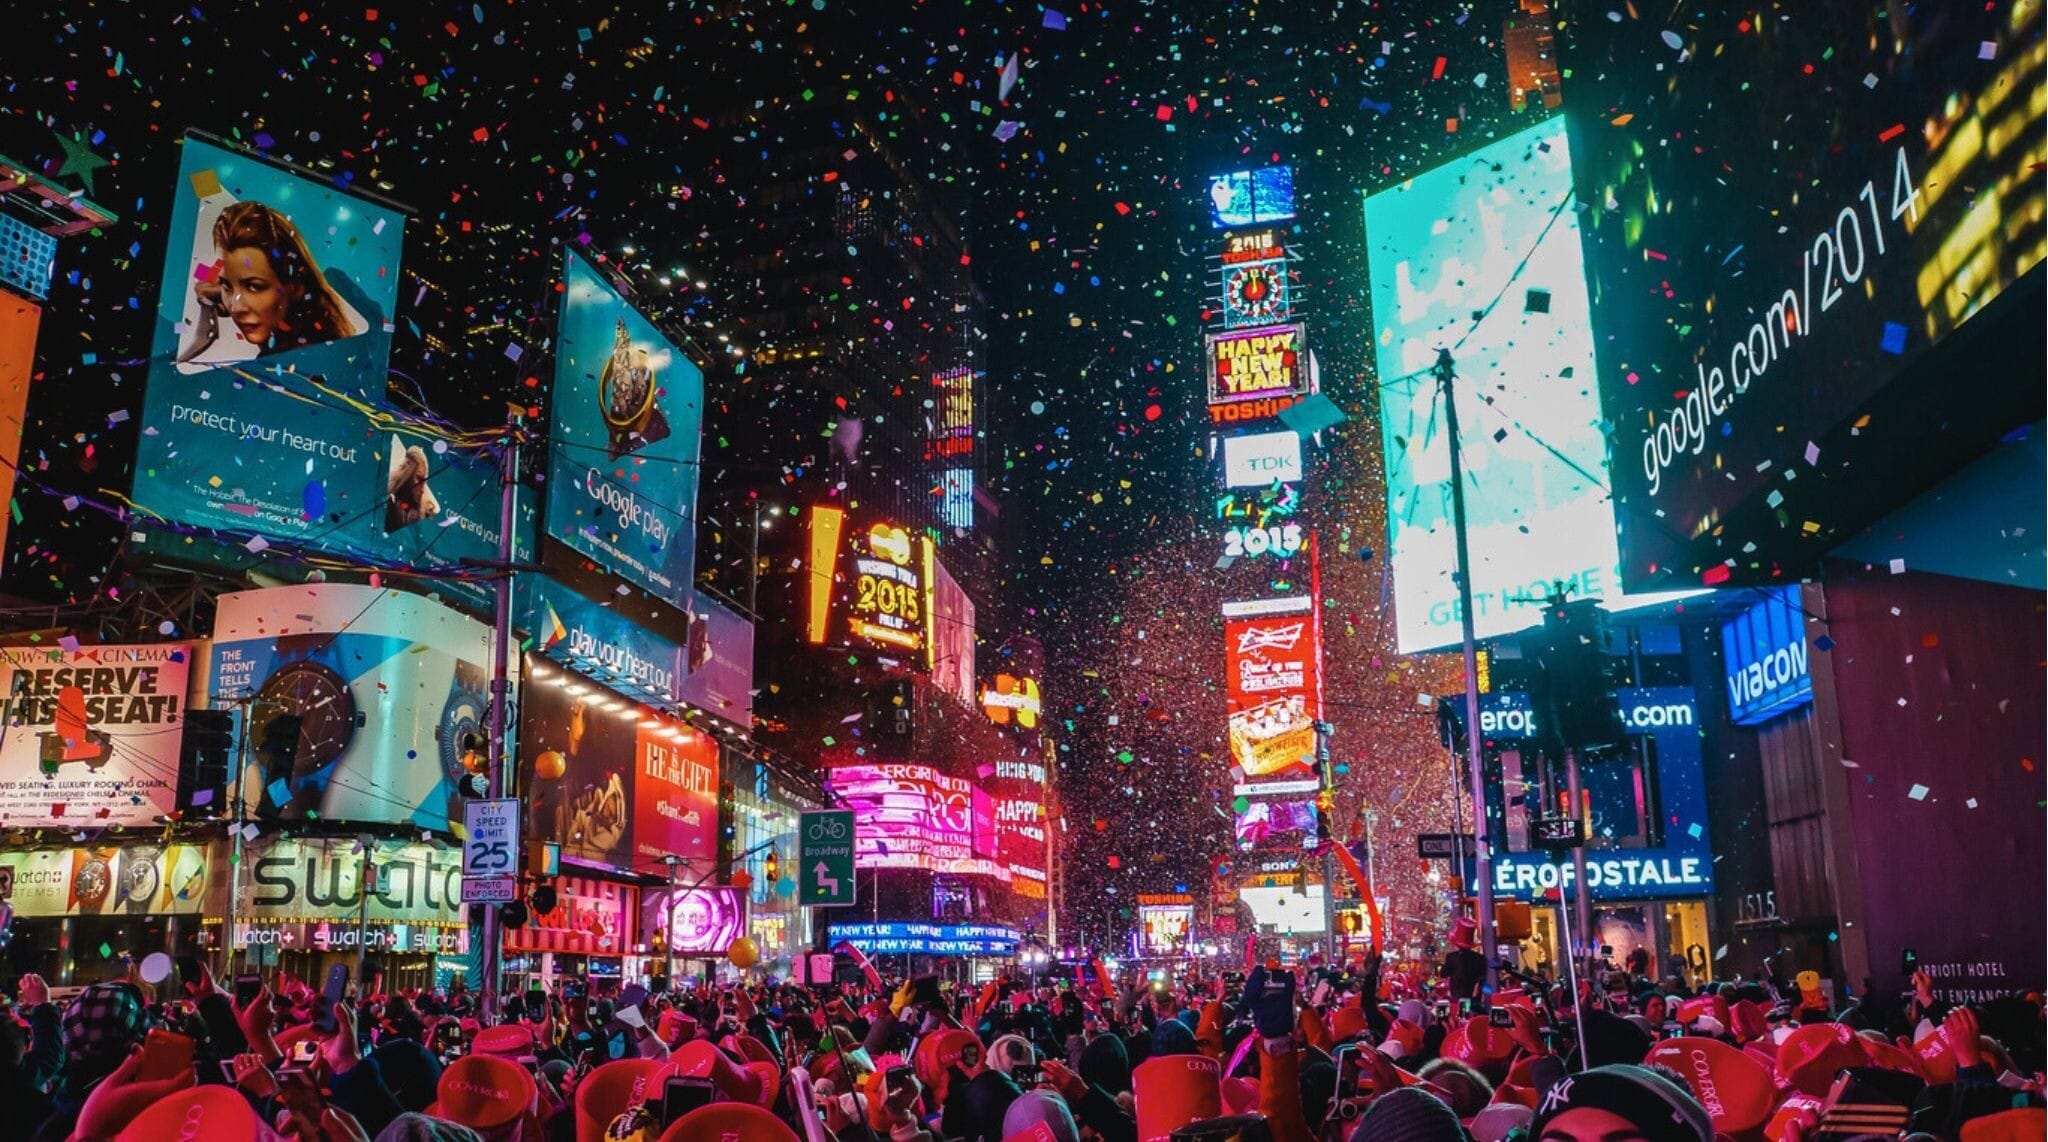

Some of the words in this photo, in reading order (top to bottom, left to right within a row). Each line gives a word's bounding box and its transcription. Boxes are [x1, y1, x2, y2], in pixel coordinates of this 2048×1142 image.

[1643, 146, 1920, 496] google.com/2014
[1217, 332, 1295, 359] HAPPY
[1231, 352, 1284, 375] NEW
[1224, 369, 1291, 394] YEAR!
[1208, 396, 1293, 422] TOSHIB
[171, 404, 236, 433] protect
[239, 422, 279, 442] your
[282, 426, 326, 456] heart
[328, 443, 357, 463] out
[1248, 457, 1293, 471] TDK
[586, 467, 642, 529] Google
[642, 509, 670, 550] play
[1225, 525, 1302, 556] 2015
[857, 574, 919, 621] 2015
[220, 660, 256, 674] FRONT
[221, 649, 242, 661] THE
[570, 624, 597, 657] play
[597, 638, 625, 668] your
[625, 647, 655, 686] heart
[655, 666, 672, 692] out
[11, 666, 159, 695] RESERVE
[218, 687, 239, 699] THE
[219, 673, 251, 687] TELLS
[87, 695, 178, 725] SEAT!
[645, 742, 668, 781] HE
[680, 758, 712, 797] GIFT
[476, 816, 507, 827] SPEED
[481, 806, 504, 815] CITY
[470, 841, 510, 869] 25
[805, 846, 850, 857] Broadway
[252, 850, 463, 912] swatc
[466, 889, 510, 898] ENFORCED
[474, 881, 502, 890] PHOTO
[1739, 890, 1776, 920] 1515
[313, 928, 385, 946] swatch
[413, 933, 458, 949] swatch
[1967, 962, 2006, 977] HOTEL
[1691, 1049, 1726, 1117] COVERGIRL
